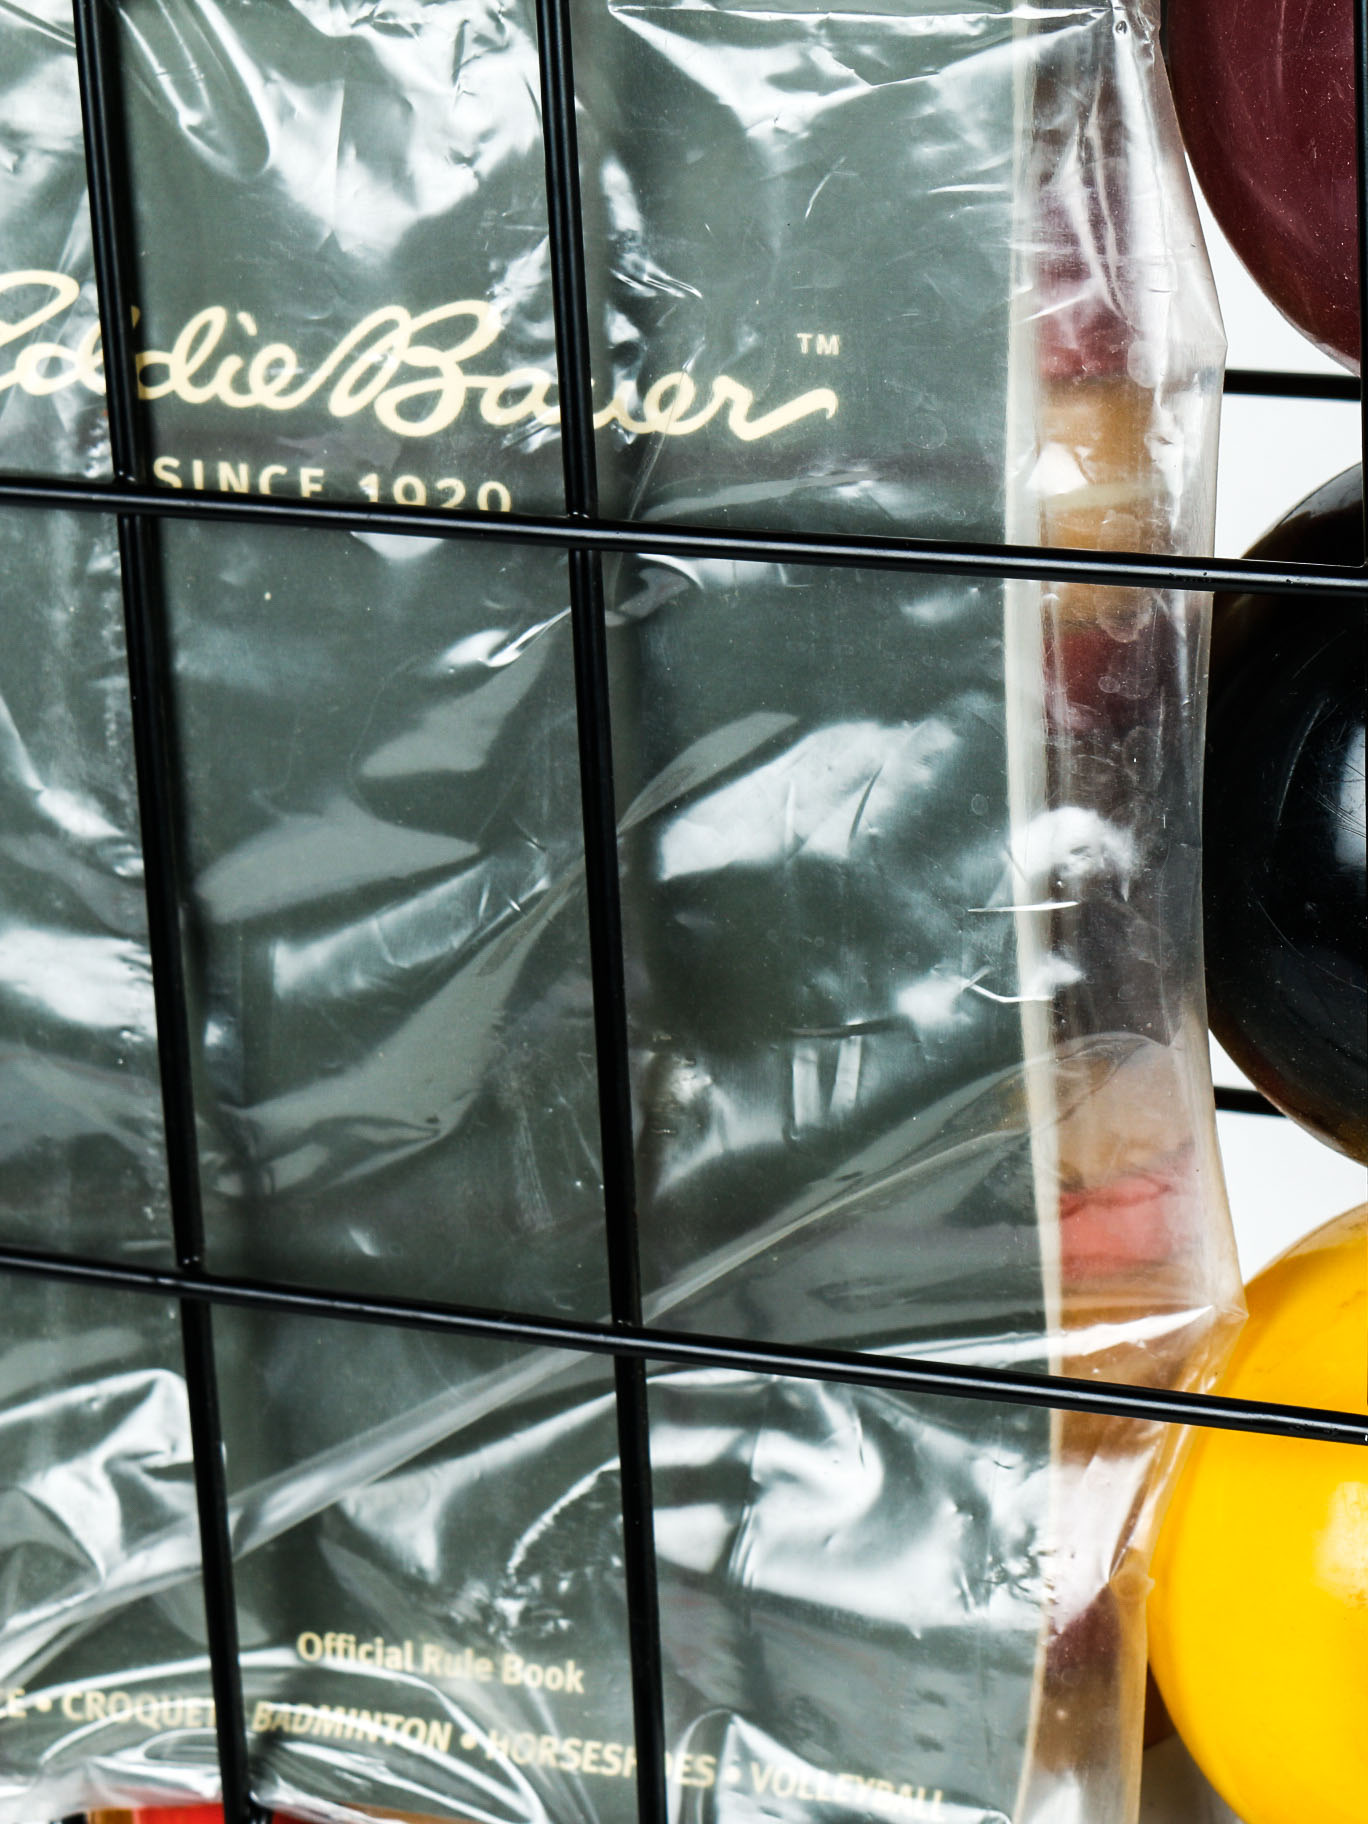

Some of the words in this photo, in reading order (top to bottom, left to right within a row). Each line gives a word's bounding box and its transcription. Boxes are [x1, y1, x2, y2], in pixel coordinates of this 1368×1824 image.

[797, 332, 840, 357] TM
[296, 1631, 414, 1673] Official
[422, 1643, 495, 1682] Rule
[501, 1652, 585, 1694] Book
[251, 1700, 453, 1753] BADMINTON
